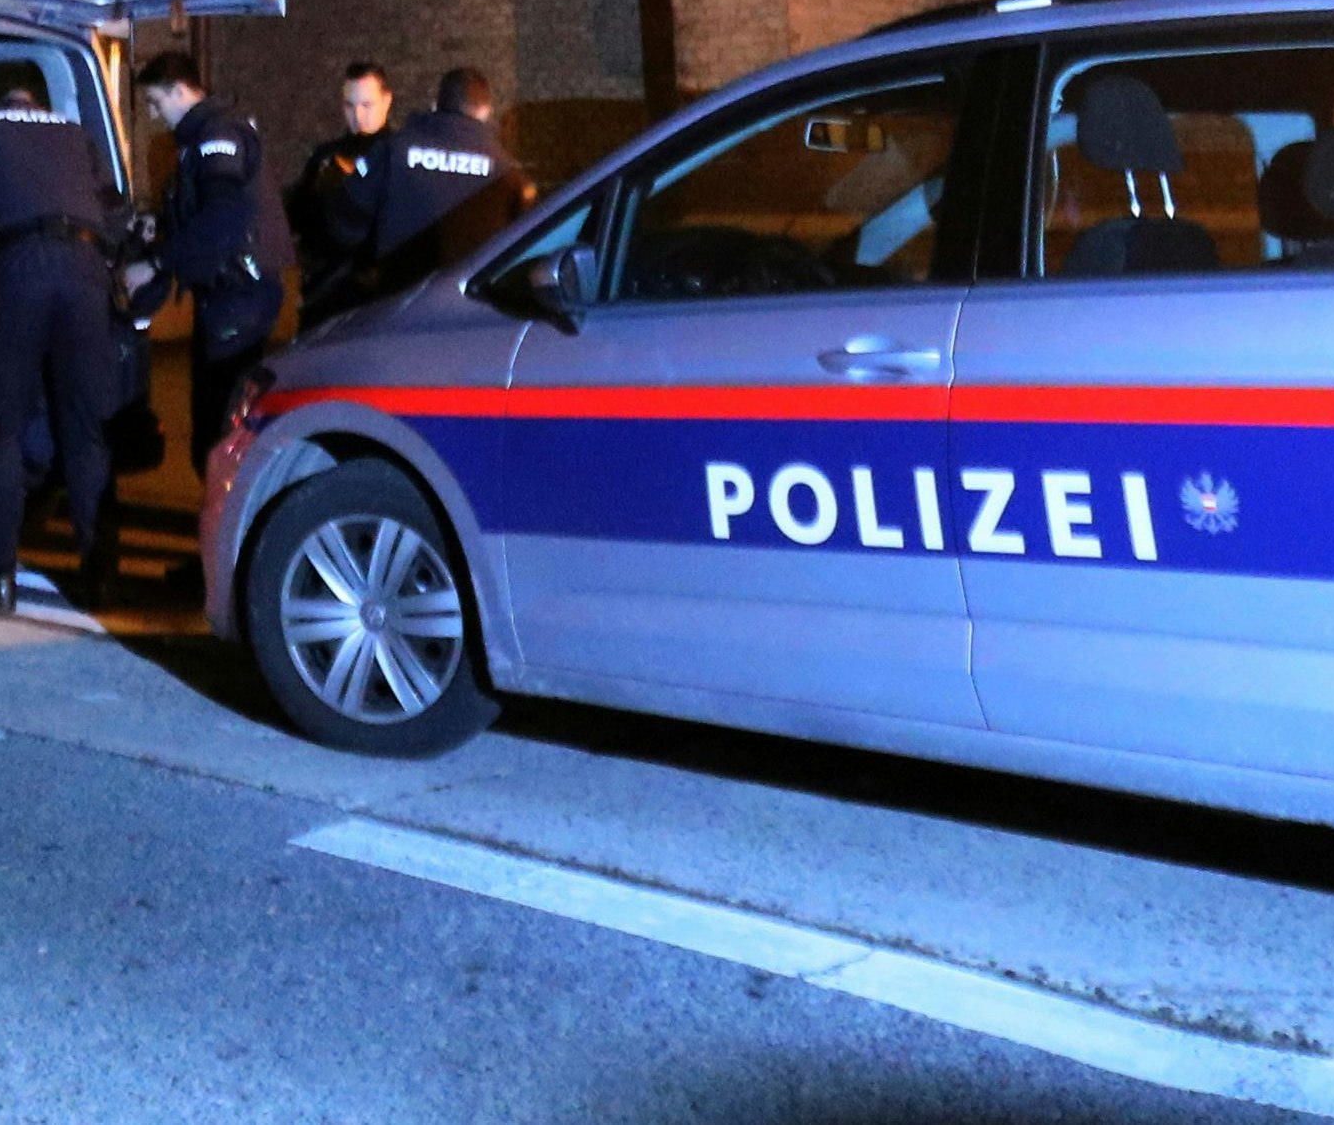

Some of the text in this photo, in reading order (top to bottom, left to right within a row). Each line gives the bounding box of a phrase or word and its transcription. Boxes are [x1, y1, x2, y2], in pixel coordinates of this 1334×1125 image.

[200, 140, 237, 157] POLIZEI
[407, 147, 491, 177] POLIZEI
[706, 461, 1158, 561] POLIZEI
